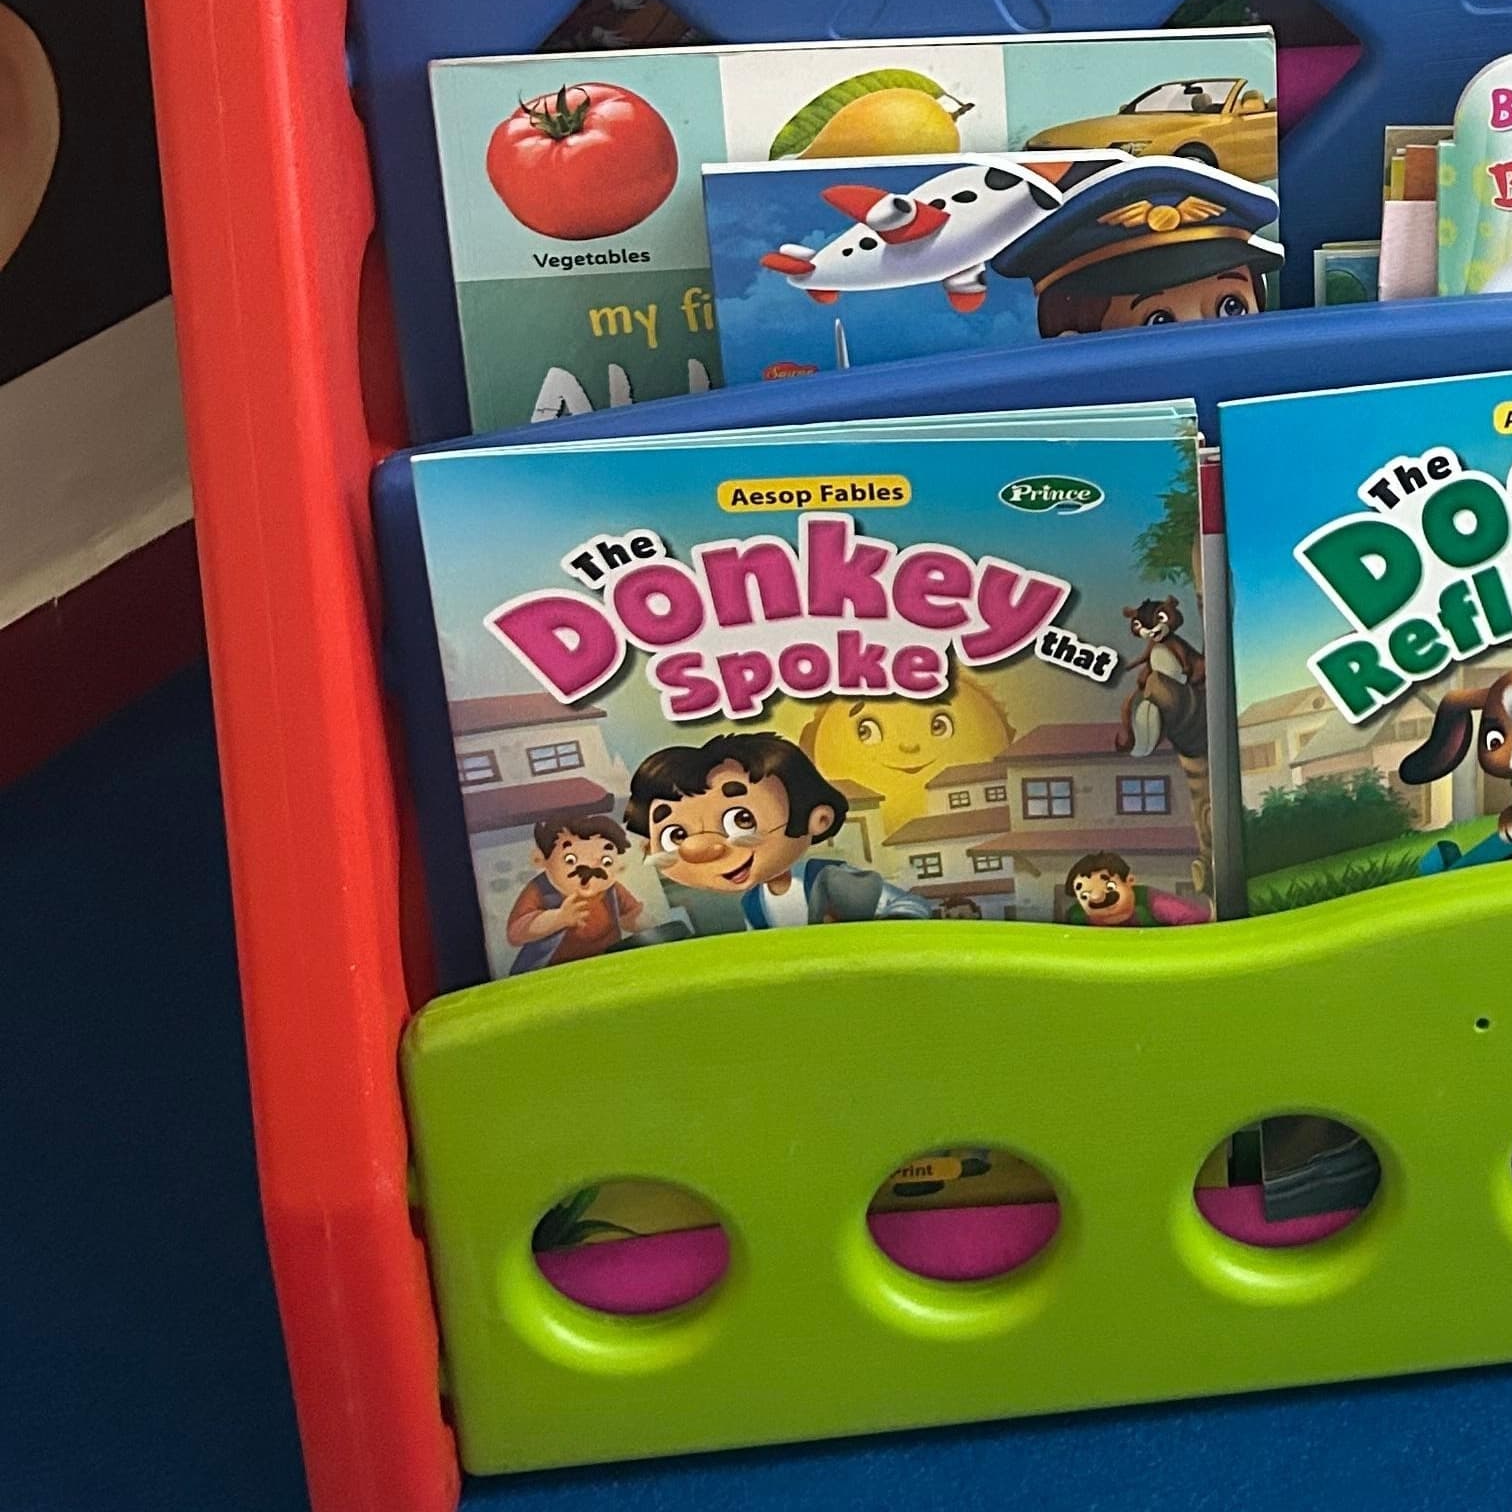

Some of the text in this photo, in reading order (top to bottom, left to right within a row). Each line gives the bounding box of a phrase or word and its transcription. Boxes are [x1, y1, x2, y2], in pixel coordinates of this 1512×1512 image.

[534, 248, 650, 270] Vegetables
[589, 303, 657, 349] my
[730, 481, 904, 508] Aesop Fables
[1009, 483, 1093, 506] Prince
[1367, 451, 1452, 510] The
[572, 531, 656, 582] The
[492, 519, 1112, 697] Donkey that
[654, 629, 945, 715] Spoke
[896, 1164, 933, 1177] rint
